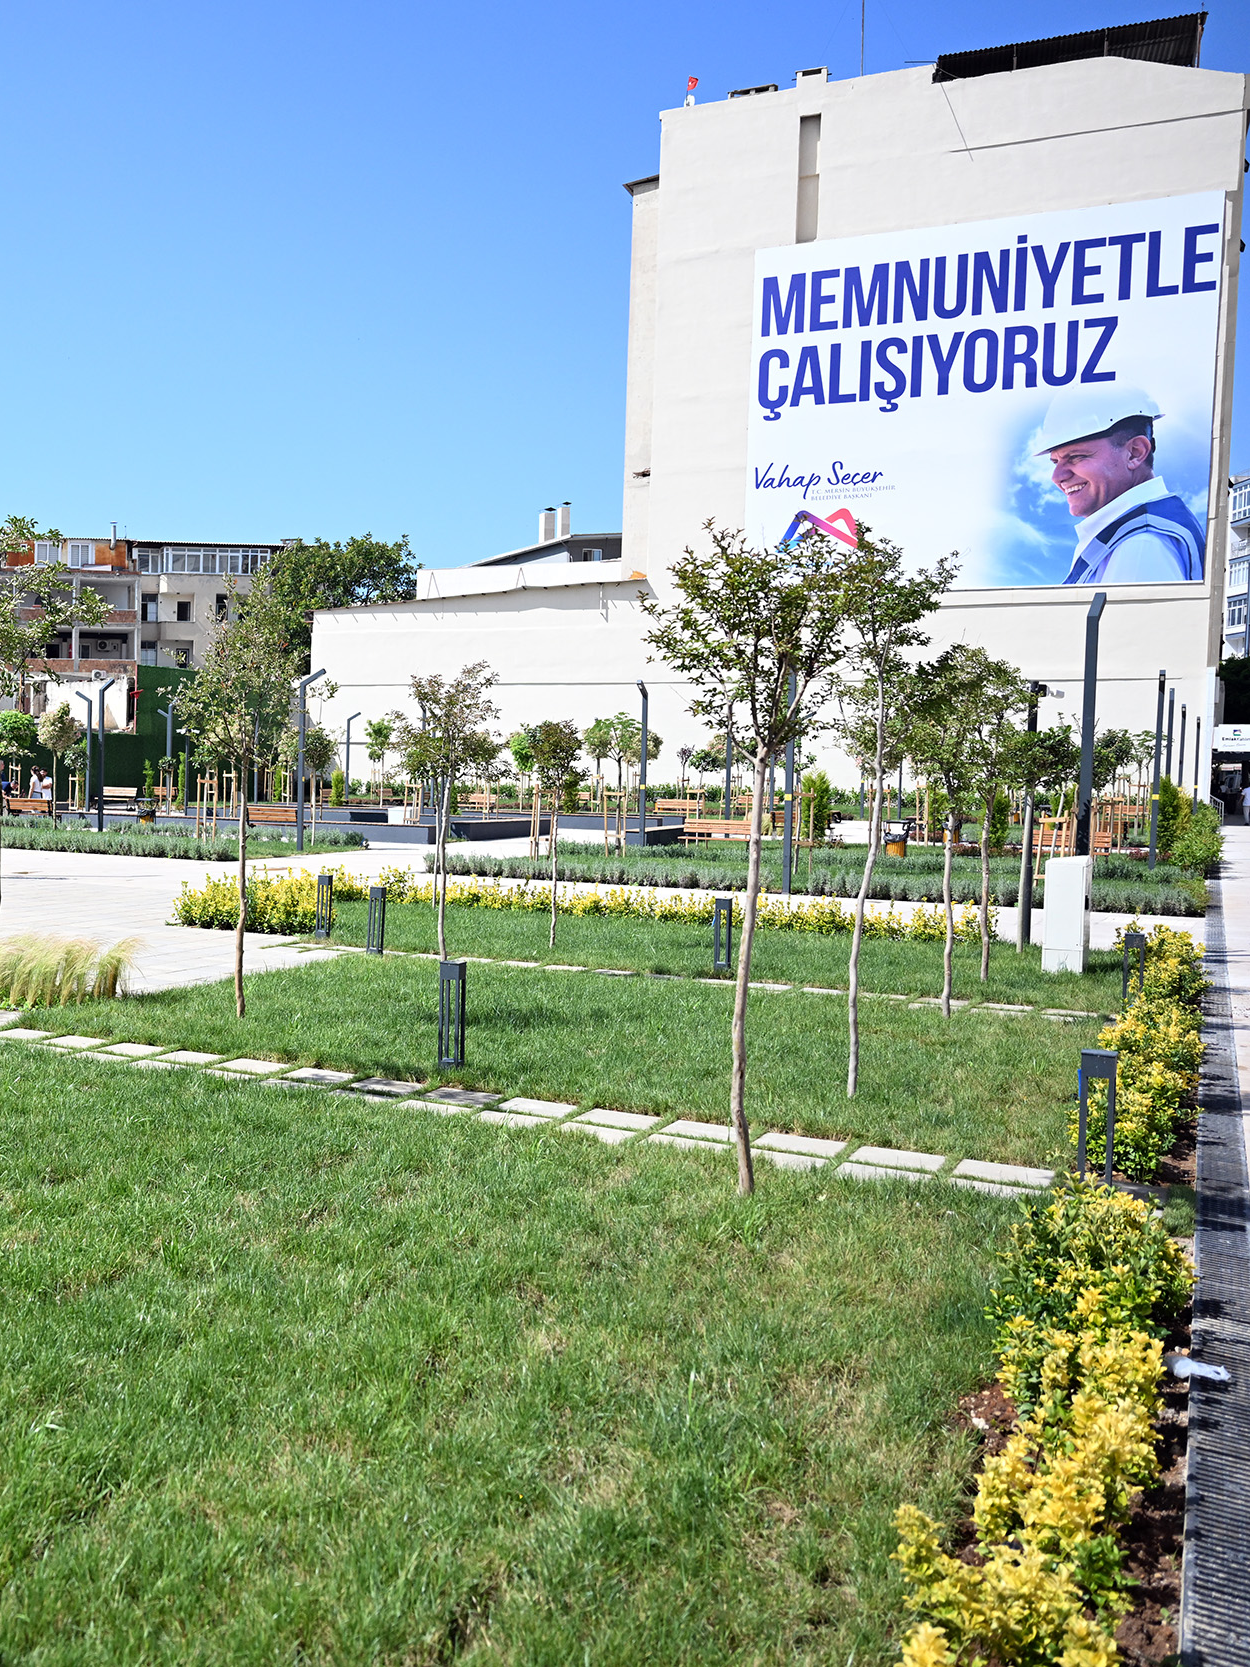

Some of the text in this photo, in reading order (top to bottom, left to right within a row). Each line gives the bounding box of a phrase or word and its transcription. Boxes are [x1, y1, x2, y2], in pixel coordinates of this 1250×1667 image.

[761, 223, 1220, 337] MEMNUNİYETLE
[757, 316, 1119, 421] ÇALIŞIYORUZ
[755, 460, 884, 500] Vahap Seçer
[824, 487, 850, 495] MERSİN
[843, 493, 872, 501] BAŞKANI
